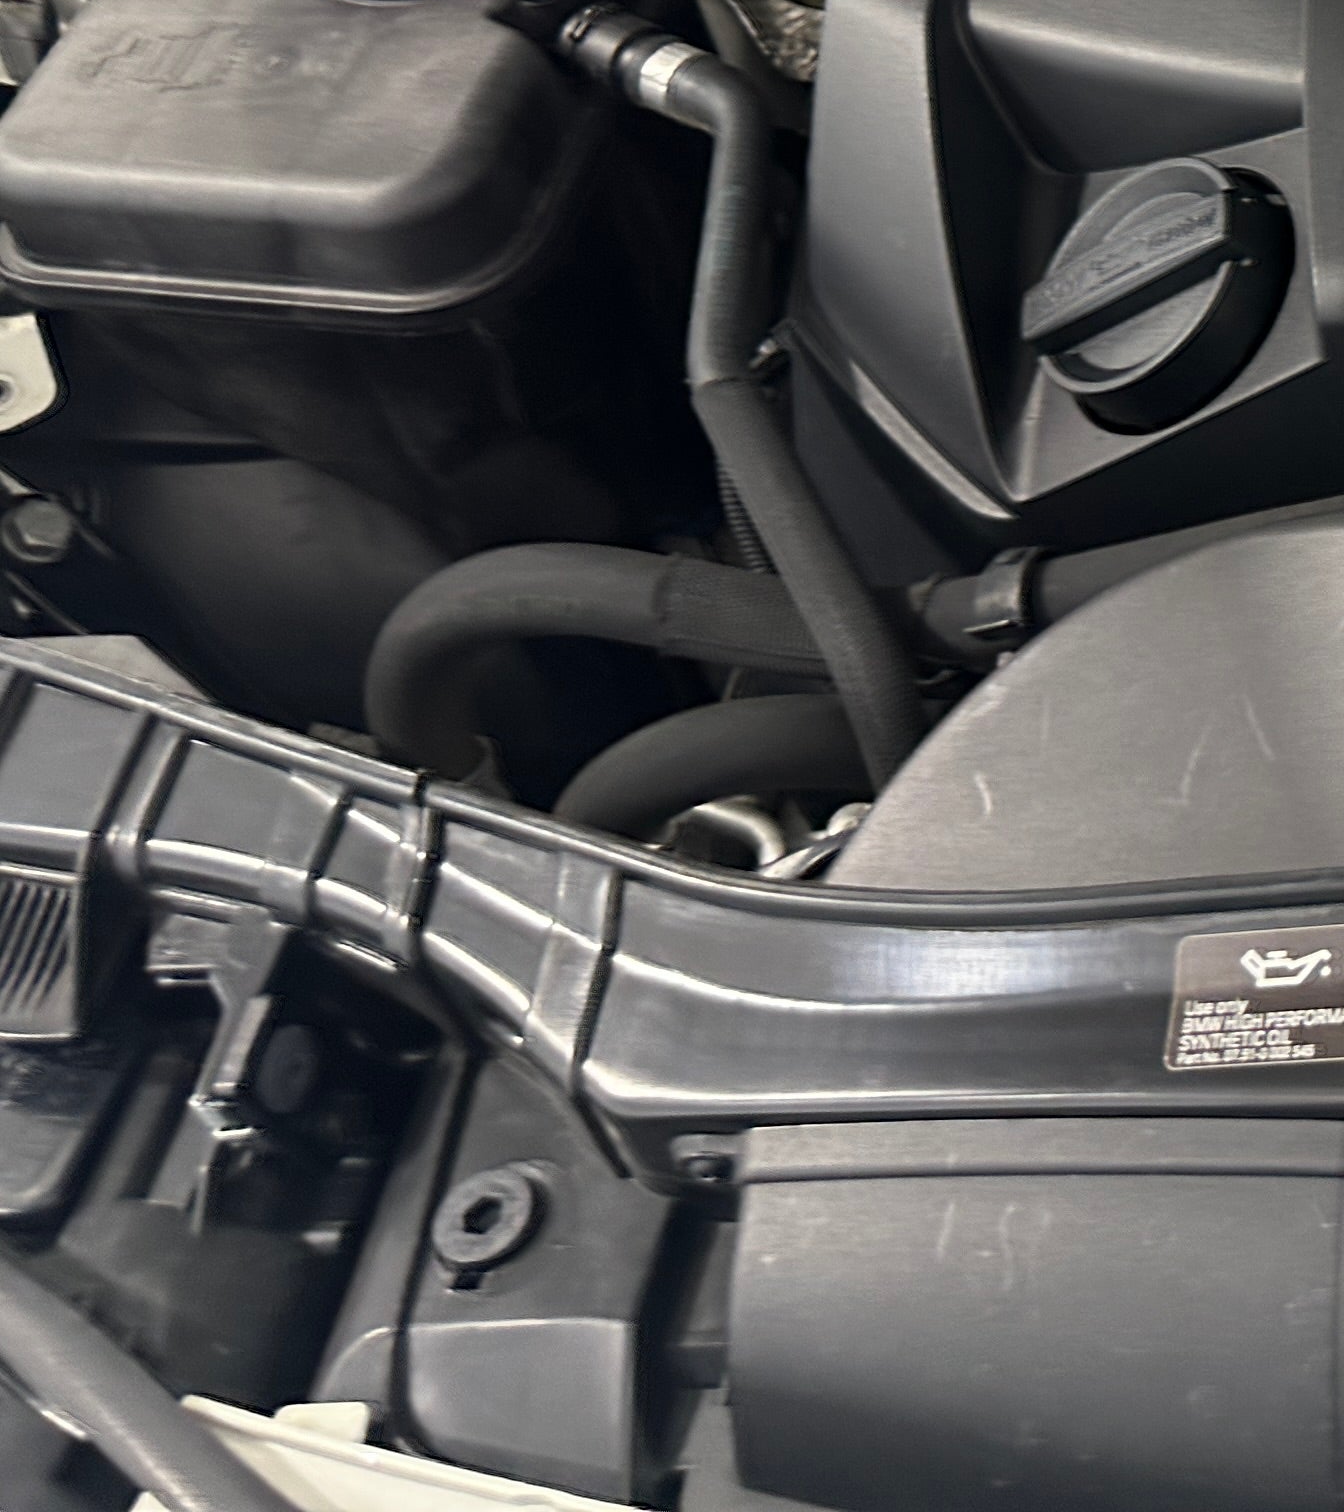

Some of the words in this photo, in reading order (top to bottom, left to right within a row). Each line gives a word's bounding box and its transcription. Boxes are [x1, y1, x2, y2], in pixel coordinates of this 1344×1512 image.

[1185, 1000, 1214, 1016] Use
[1215, 998, 1250, 1016] only
[1182, 1016, 1223, 1034] BMW
[1224, 1013, 1264, 1031] HIGH
[1178, 1030, 1266, 1052] SYNTHETIC
[1267, 1029, 1292, 1046] OIL
